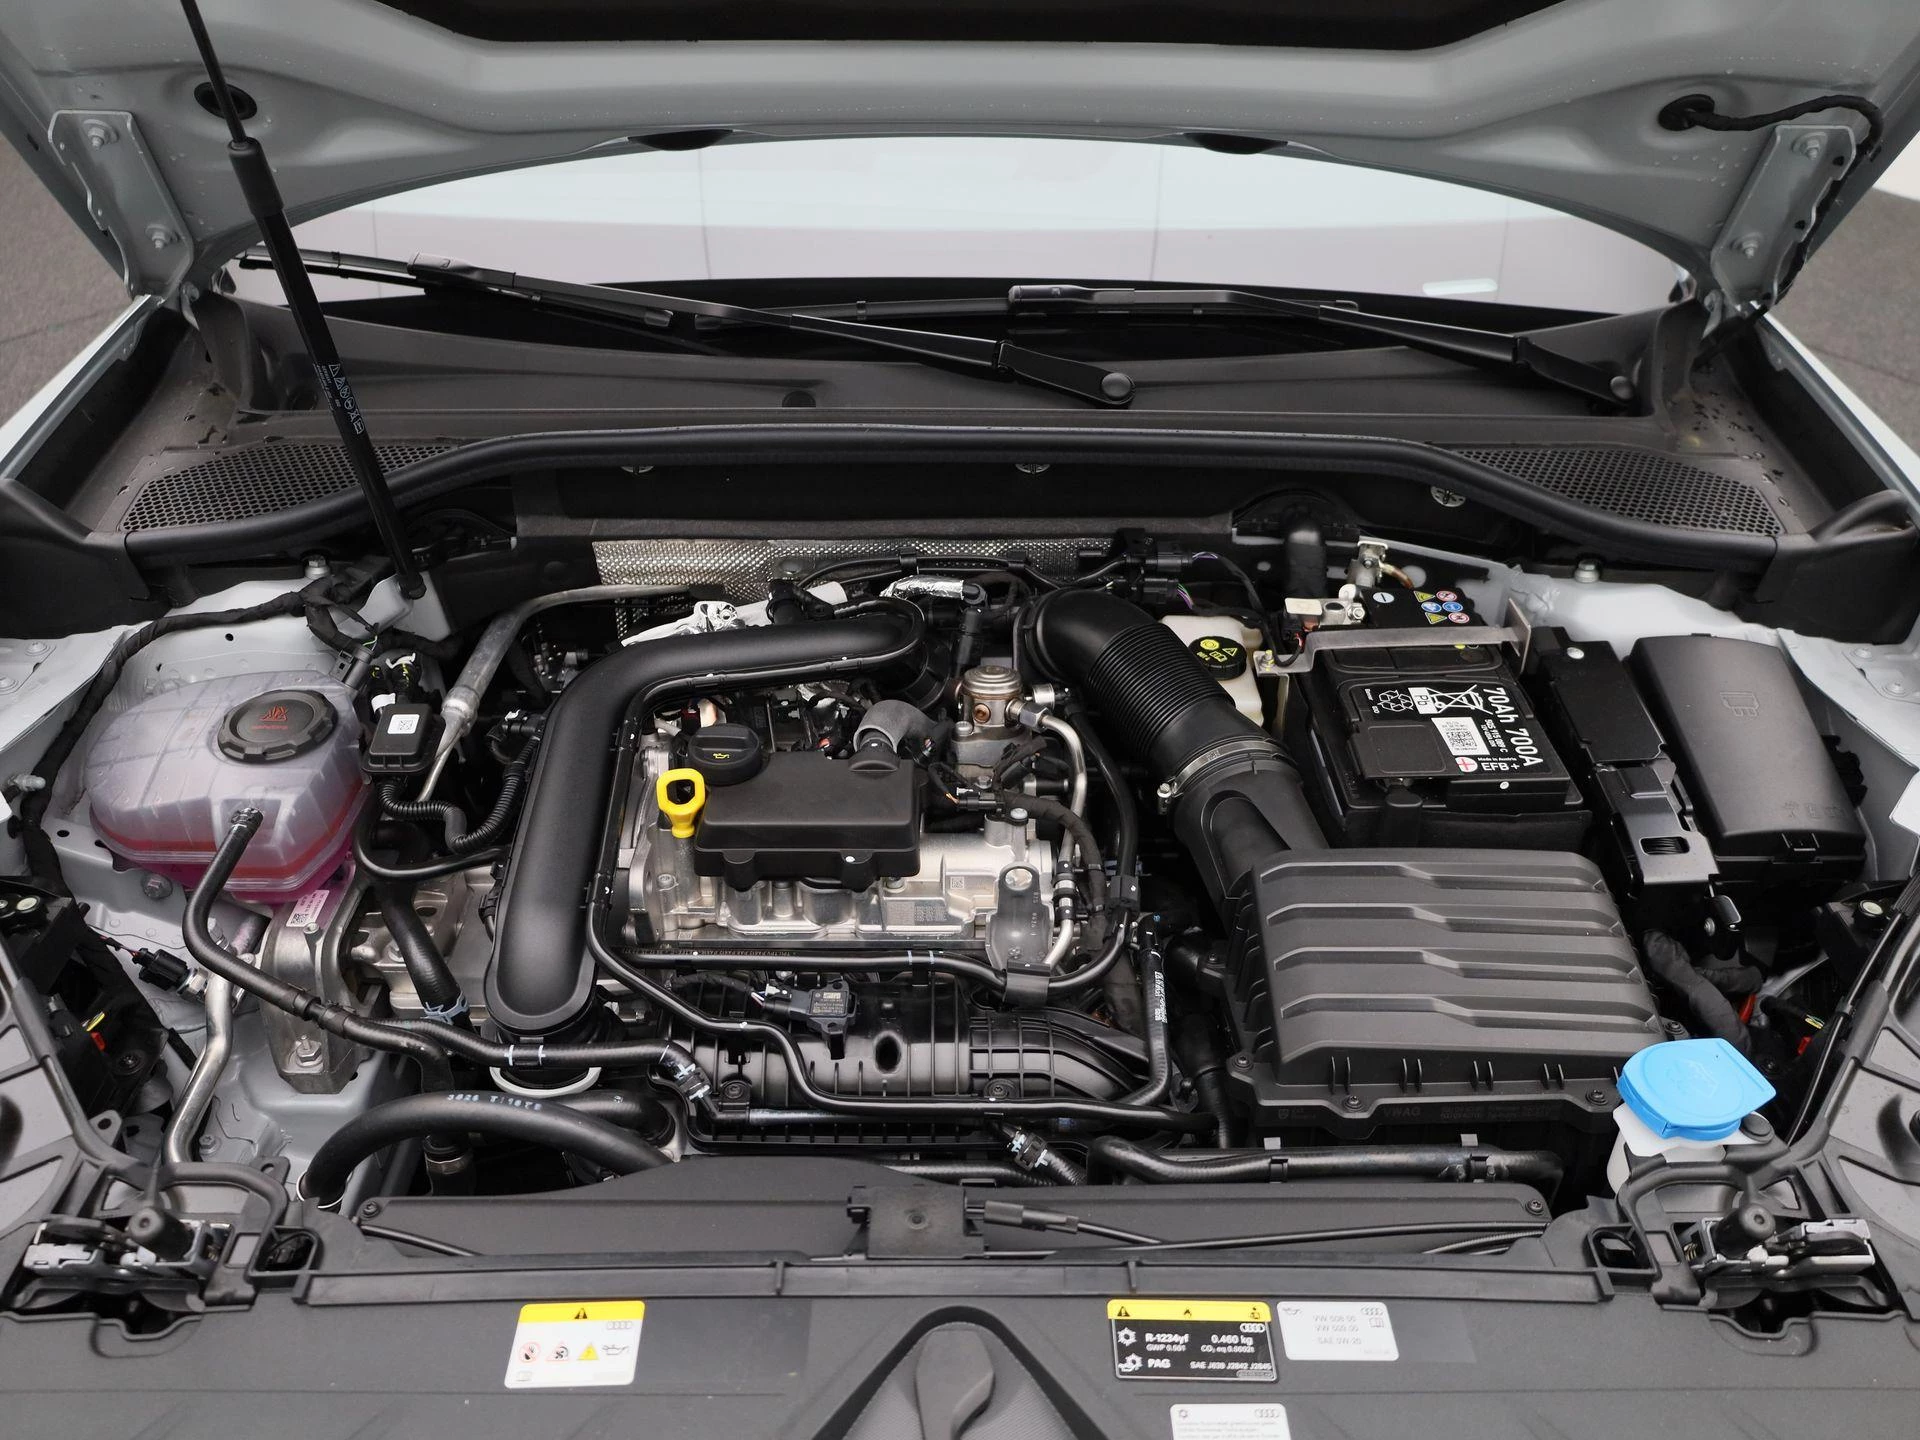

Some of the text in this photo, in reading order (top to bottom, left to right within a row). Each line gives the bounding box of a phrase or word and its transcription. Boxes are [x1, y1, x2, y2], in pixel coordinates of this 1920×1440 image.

[1414, 694, 1430, 706] Pb
[1483, 687, 1543, 766] 70Ah 700A
[1480, 762, 1510, 771] EFB
[1145, 1332, 1189, 1345] R-1234yf
[1240, 1334, 1254, 1346] kg
[1147, 1358, 1171, 1369] PAG
[1190, 1361, 1206, 1369] SAE
